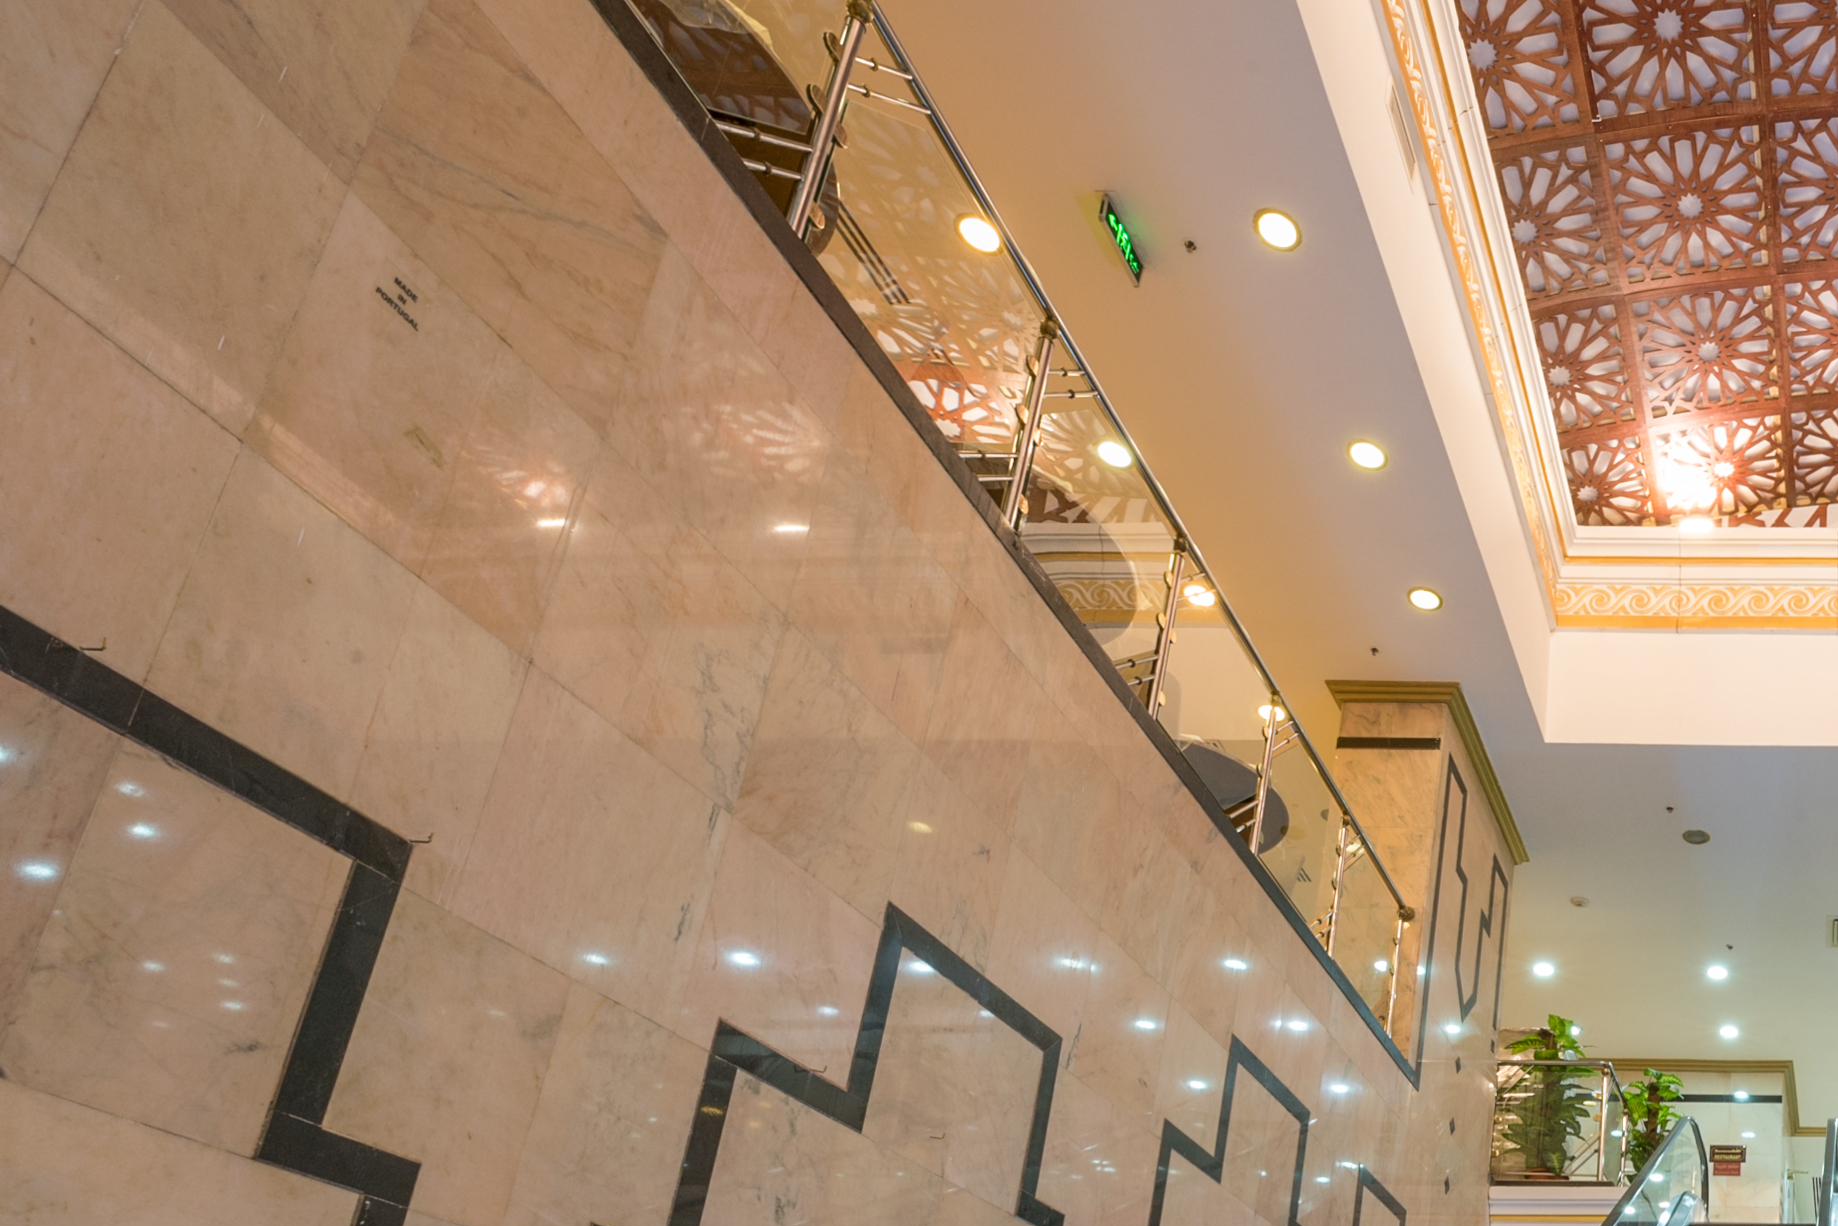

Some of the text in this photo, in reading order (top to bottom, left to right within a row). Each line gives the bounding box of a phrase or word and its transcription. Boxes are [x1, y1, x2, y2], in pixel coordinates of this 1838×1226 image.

[394, 277, 418, 303] MADE
[397, 293, 407, 305] IN
[375, 286, 419, 332] PORTUGAL
